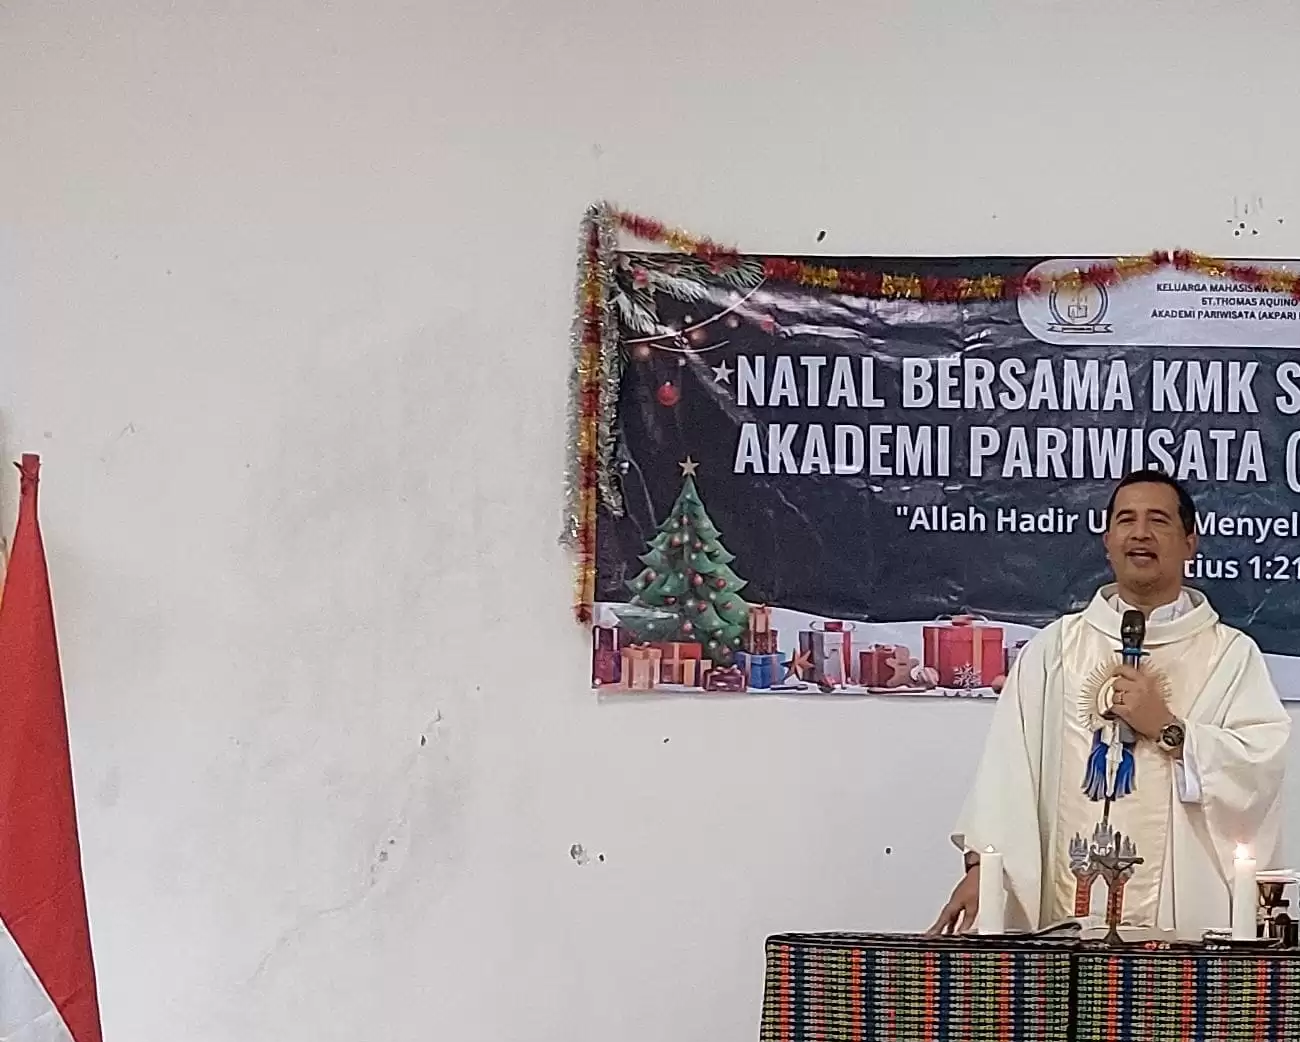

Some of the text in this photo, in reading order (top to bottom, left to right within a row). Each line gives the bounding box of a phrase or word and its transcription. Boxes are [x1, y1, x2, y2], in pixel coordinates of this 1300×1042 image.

[1156, 283, 1207, 292] KELUARGA
[1201, 297, 1298, 307] ST.THOMAS AQUINO
[1151, 309, 1195, 319] AKADEMI
[1197, 310, 1256, 320] PARIWISATA
[1258, 311, 1297, 320] (AKPAR)
[735, 354, 886, 410] NATAL
[902, 356, 1133, 412] BERSAMA
[1152, 360, 1260, 414] KMK
[733, 422, 951, 478] AKADEMI
[969, 426, 1268, 484] PARIWISATA
[896, 505, 987, 533] "Allah
[998, 506, 1079, 534] Hadir
